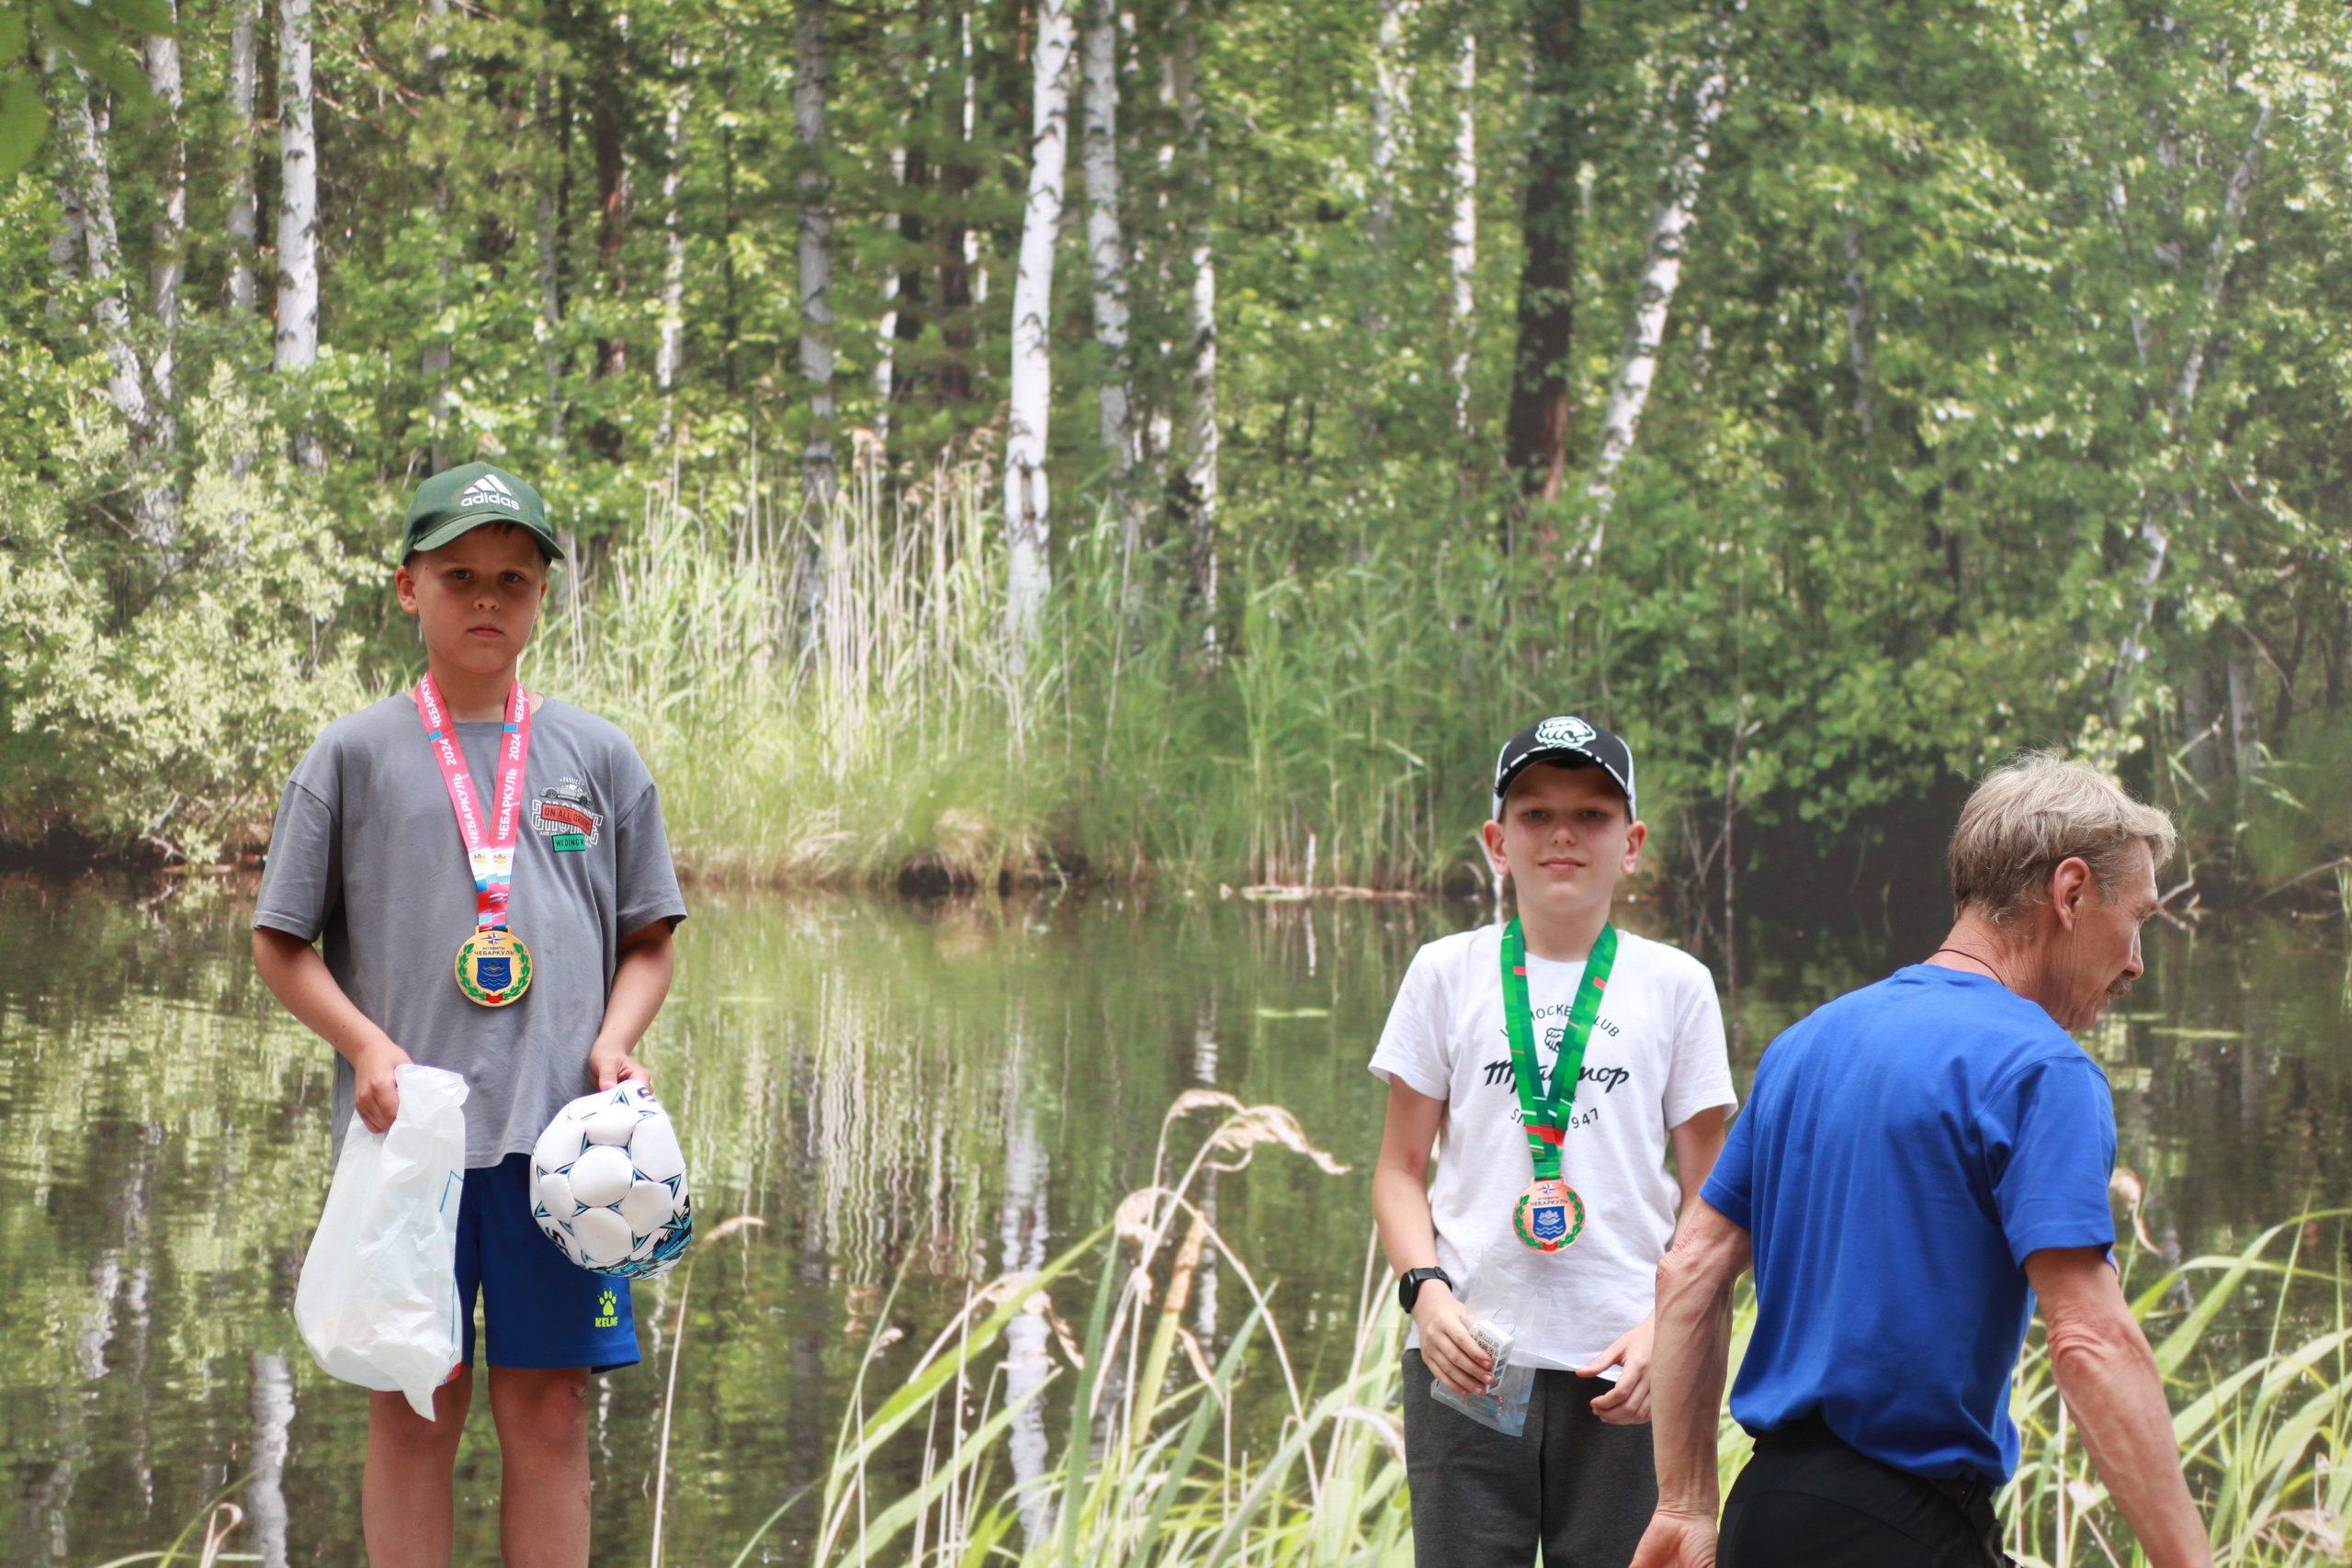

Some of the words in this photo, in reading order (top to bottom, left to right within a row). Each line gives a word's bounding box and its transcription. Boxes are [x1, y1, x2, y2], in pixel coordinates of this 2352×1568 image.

[461, 491, 520, 511] adidas
[439, 738, 458, 765] 2024
[497, 768, 517, 840] ЧЕБАРКУЛЬ
[508, 733, 522, 761] 2024
[453, 773, 480, 844] ЧЕБАРКУЛЬ
[544, 807, 556, 818] ON
[558, 810, 571, 820] ALL
[1593, 1015, 1620, 1037] LUB
[1571, 1108, 1599, 1129] 947
